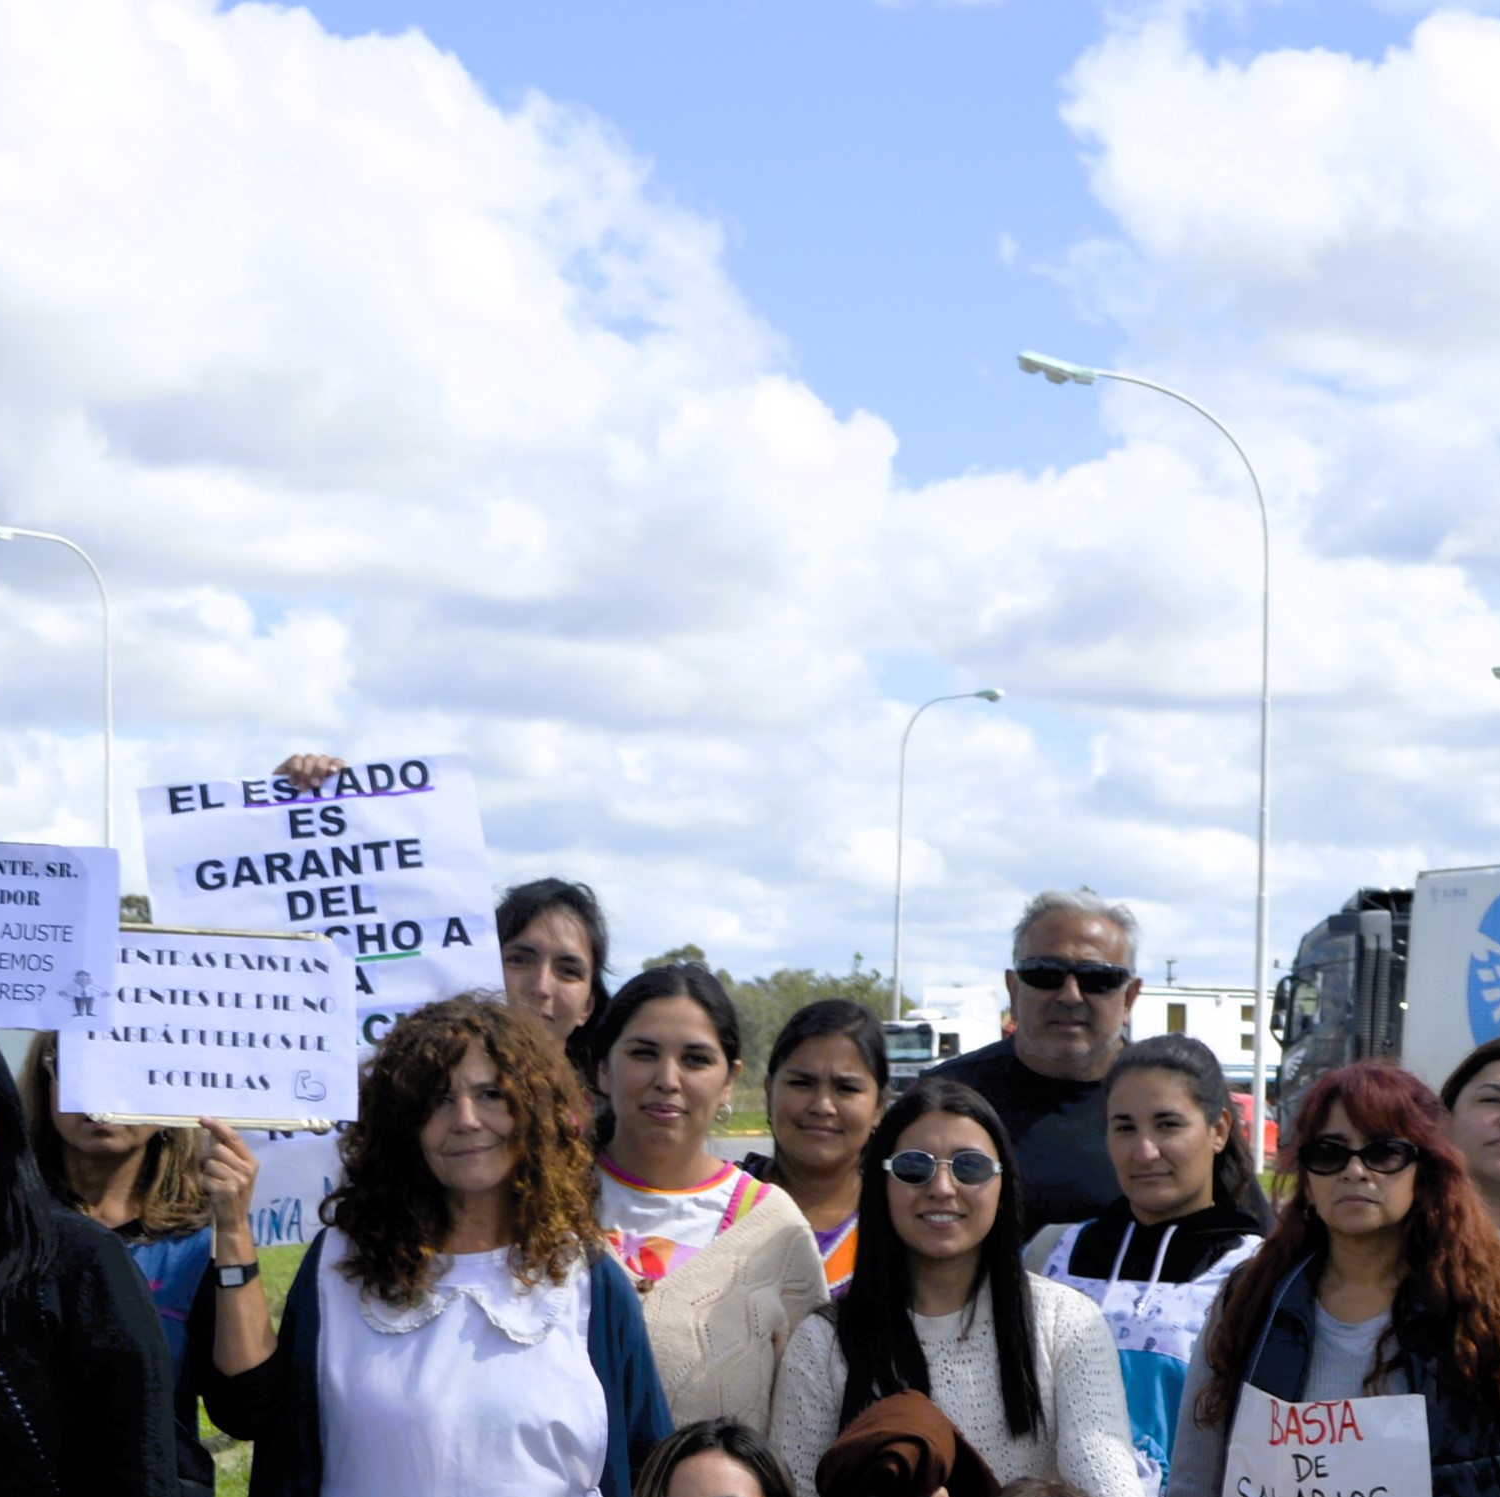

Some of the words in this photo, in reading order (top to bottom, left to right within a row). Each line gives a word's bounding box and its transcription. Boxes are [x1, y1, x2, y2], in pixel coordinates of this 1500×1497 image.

[168, 783, 225, 815] EL
[288, 806, 347, 840] ES
[45, 862, 79, 878] SR.
[195, 838, 424, 891] GARANTE
[286, 885, 377, 922] DEL
[1, 923, 74, 942] AJUSTE
[442, 917, 472, 948] A
[225, 953, 329, 974] EXISTAN
[218, 992, 249, 1009] DE
[256, 994, 296, 1011] PIE
[303, 996, 336, 1014] NO
[181, 1029, 292, 1050] PUEBLOS
[300, 1035, 331, 1052] DE
[148, 1069, 271, 1091] RODILLAS
[1268, 1399, 1364, 1446] BASTA
[1292, 1453, 1330, 1482] DE
